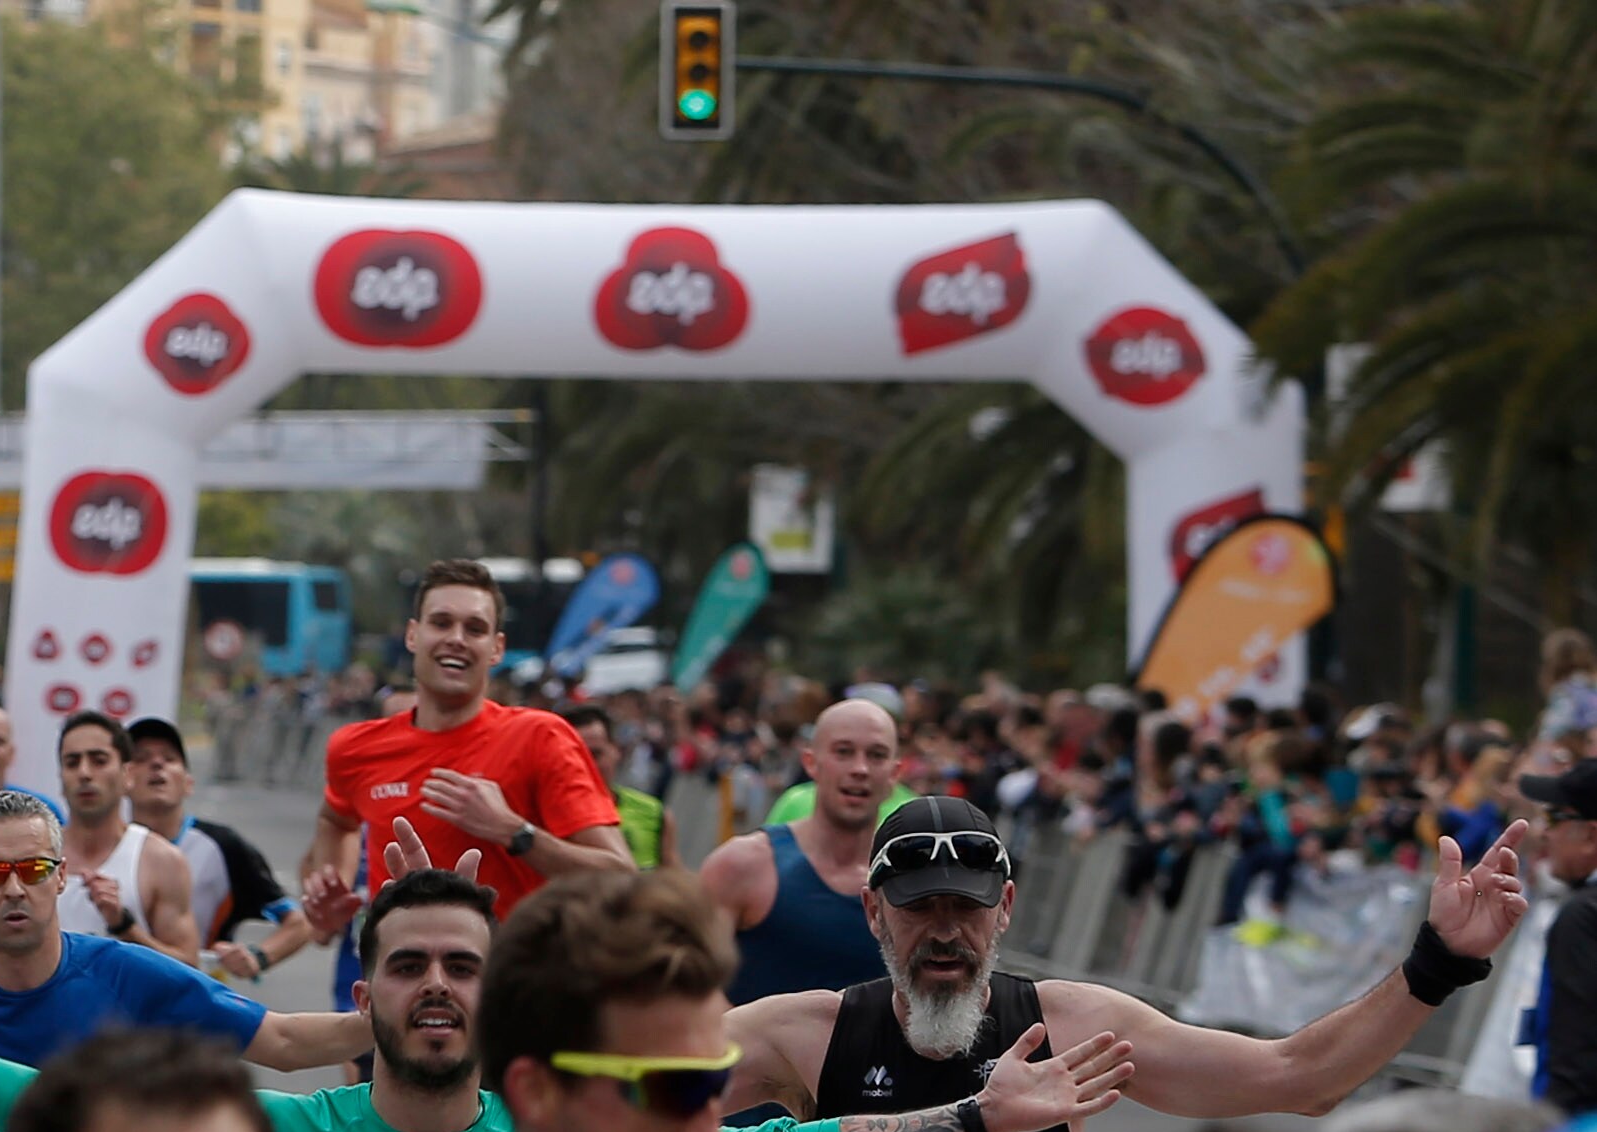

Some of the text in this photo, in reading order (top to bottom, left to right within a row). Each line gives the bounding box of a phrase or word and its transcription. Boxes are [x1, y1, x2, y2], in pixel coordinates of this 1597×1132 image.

[351, 255, 439, 320] edp
[625, 260, 715, 323] edp
[920, 262, 1006, 325] edp
[165, 320, 228, 367] edp
[1110, 331, 1182, 379] edp
[71, 497, 141, 549] edp
